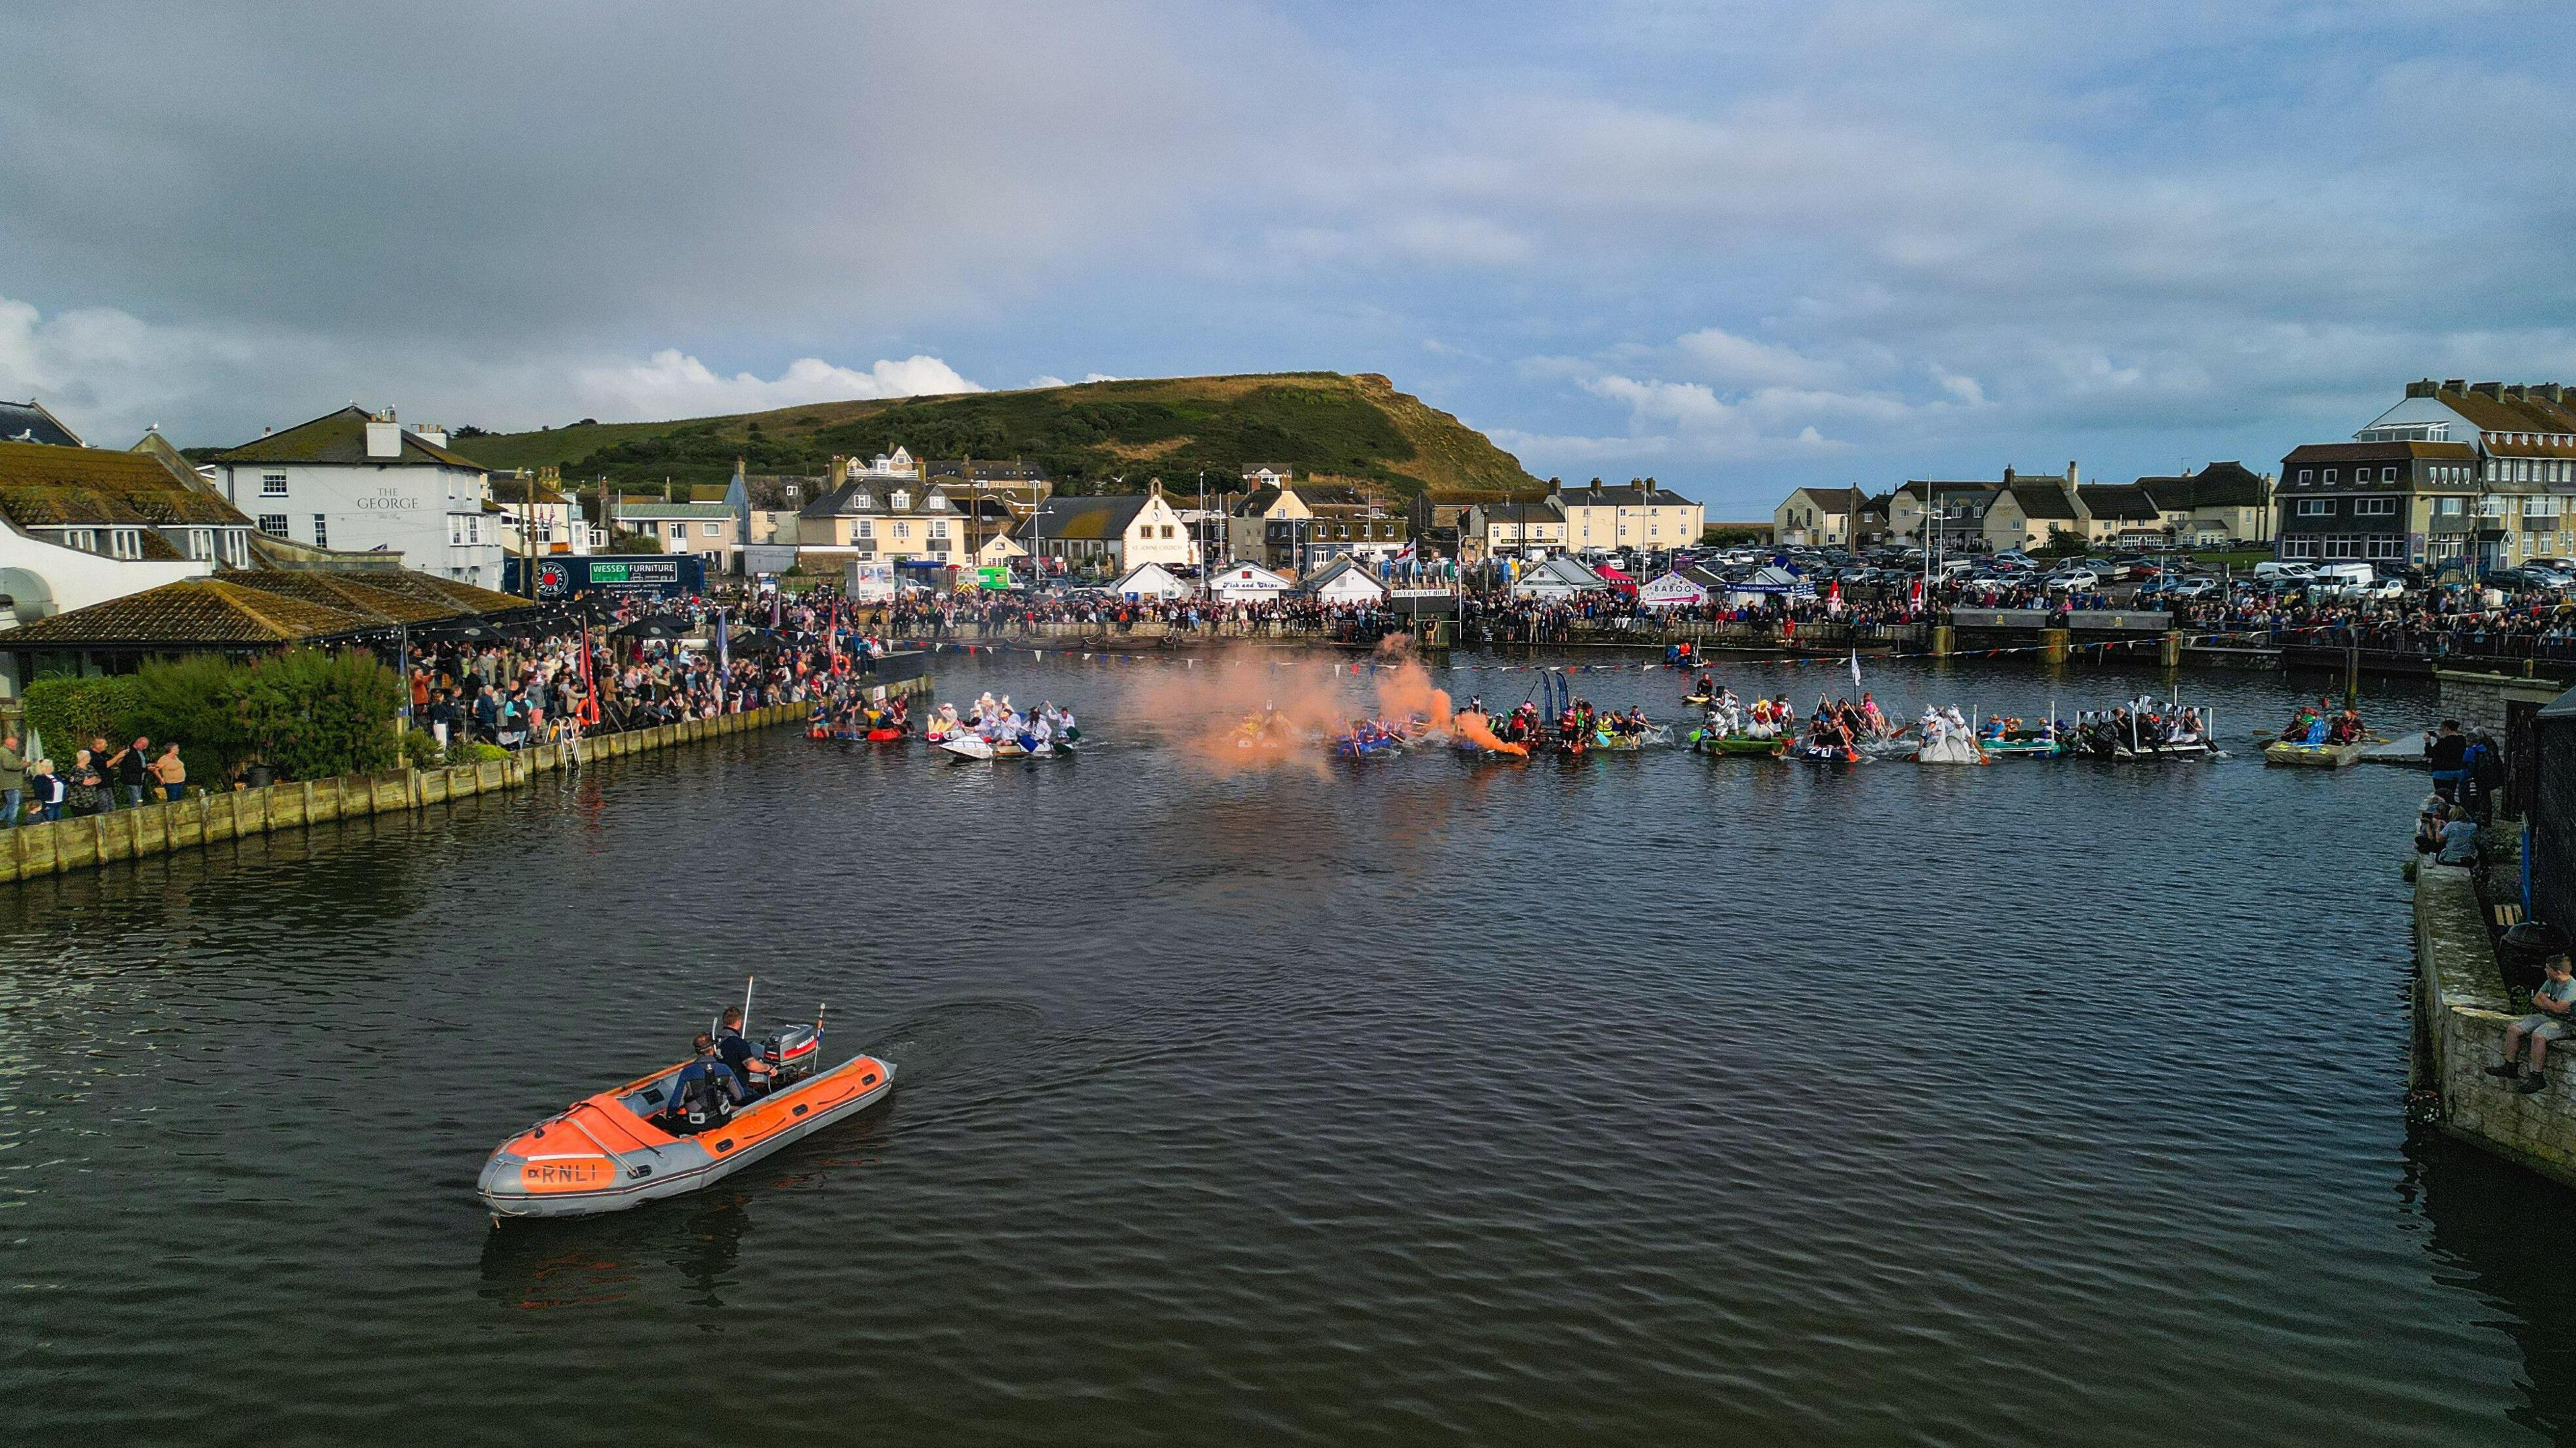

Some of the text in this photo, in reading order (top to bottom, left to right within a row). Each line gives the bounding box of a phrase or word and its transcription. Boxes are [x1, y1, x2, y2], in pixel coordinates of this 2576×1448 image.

[377, 488, 398, 496] THE
[357, 498, 419, 509] GEORGE
[593, 564, 674, 573] WESSEX FURNITURE
[542, 1164, 596, 1183] RNLI
